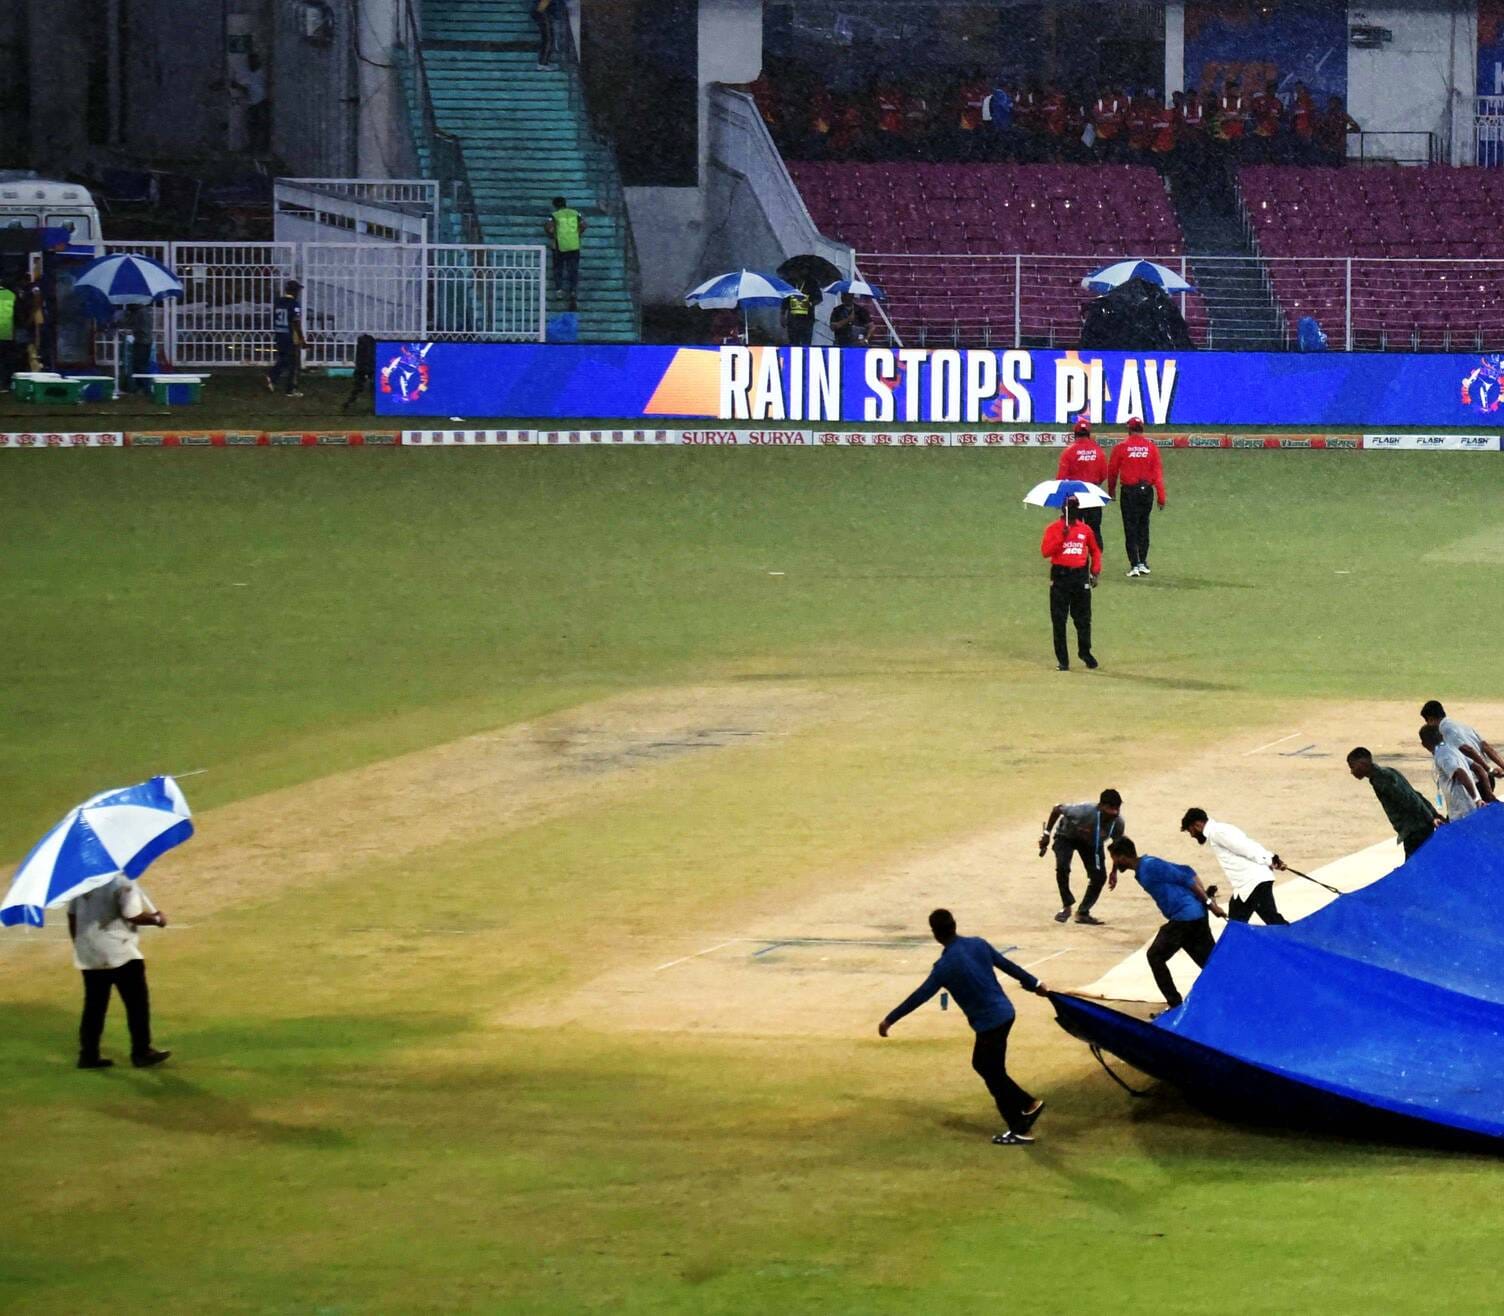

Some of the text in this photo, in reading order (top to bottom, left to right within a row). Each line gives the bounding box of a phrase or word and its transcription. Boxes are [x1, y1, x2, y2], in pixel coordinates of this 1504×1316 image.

[720, 345, 840, 420] RAIN
[865, 349, 1032, 422] STOPS
[682, 431, 805, 444] SURYA SURYA
[819, 434, 945, 444] NSC NSC NSC NSC NSC
[957, 434, 1076, 443] NSC NSC NSC NSC NS
[1460, 437, 1489, 445] FLASH
